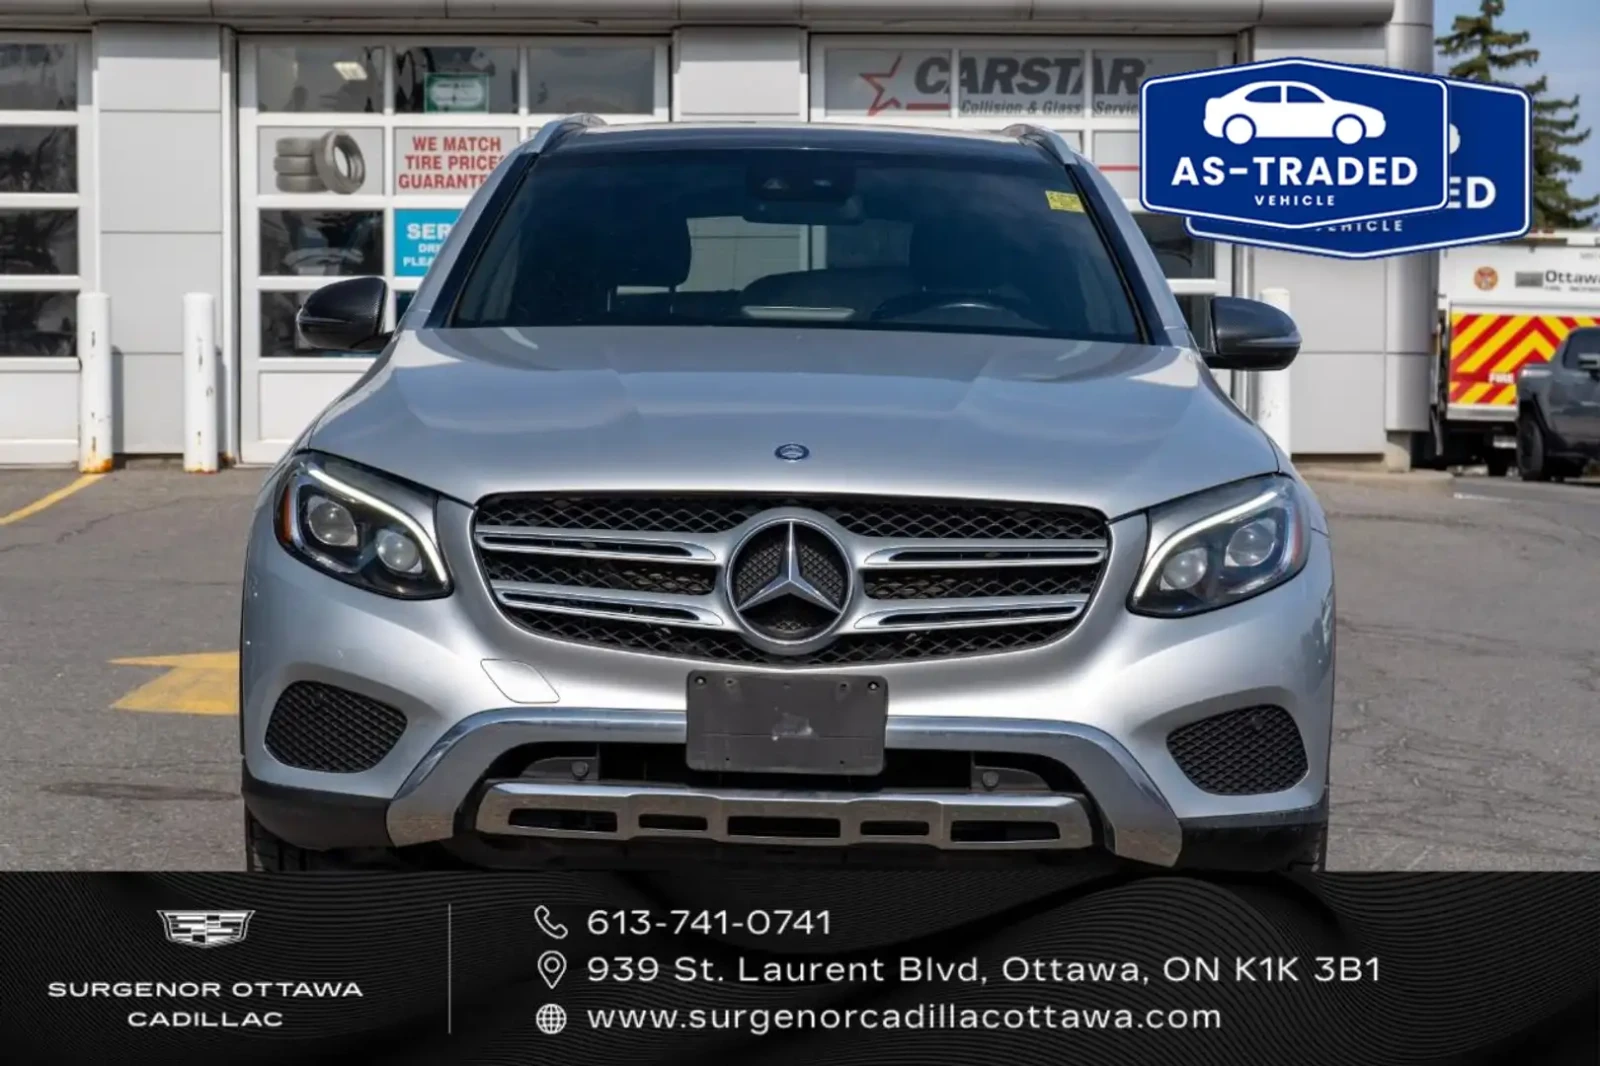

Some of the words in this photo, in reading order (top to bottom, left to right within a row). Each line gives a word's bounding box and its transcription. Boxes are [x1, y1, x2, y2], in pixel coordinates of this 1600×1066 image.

[914, 56, 1145, 95] CARSTAR
[960, 100, 1021, 115] Collision
[1027, 101, 1038, 114] &
[1043, 100, 1081, 115] Glass
[412, 136, 437, 151] WE
[443, 136, 502, 151] MATCH
[405, 155, 442, 170] TIRE
[1545, 269, 1600, 284] Ottaw
